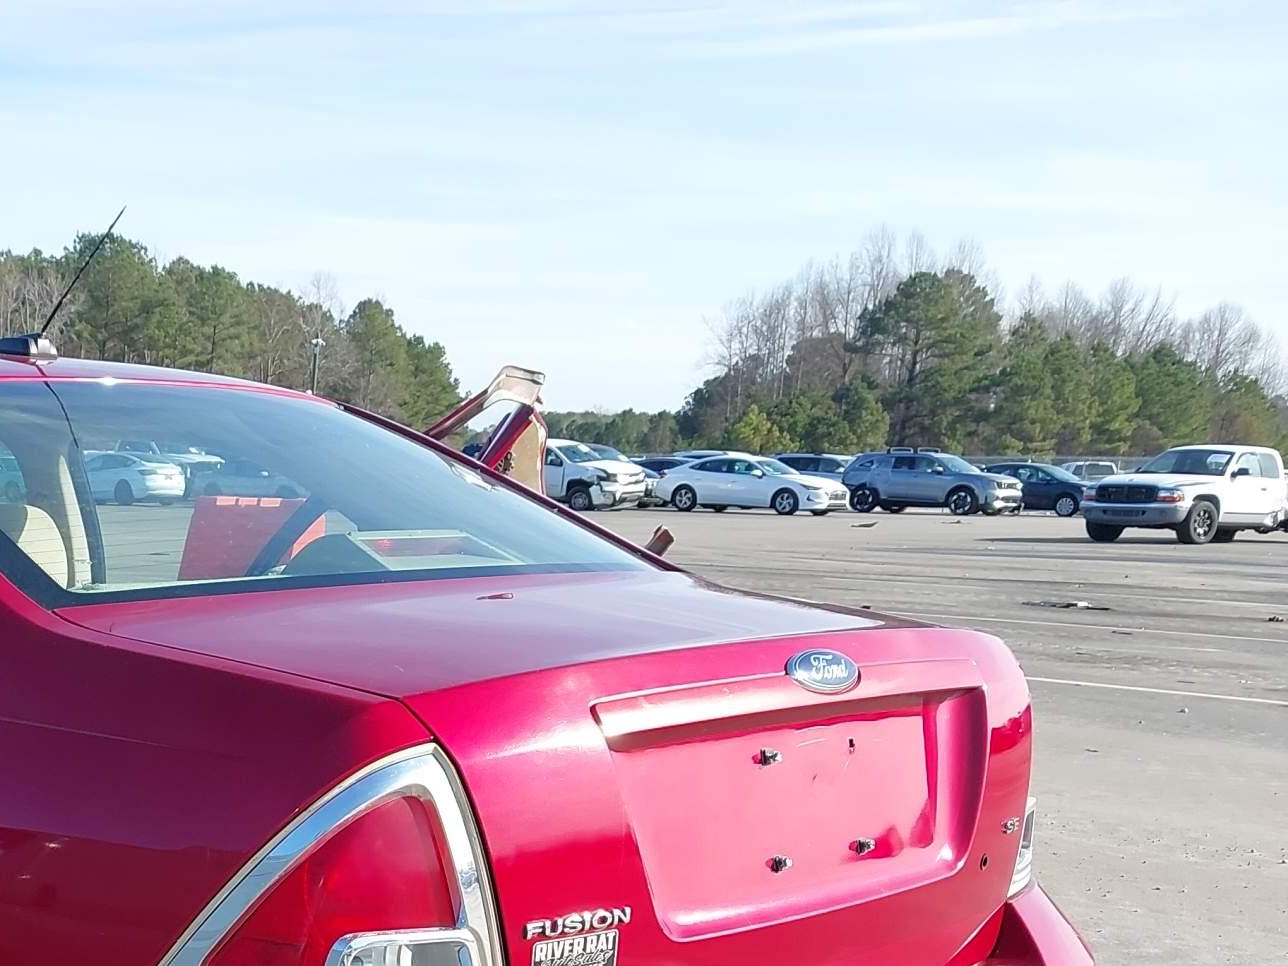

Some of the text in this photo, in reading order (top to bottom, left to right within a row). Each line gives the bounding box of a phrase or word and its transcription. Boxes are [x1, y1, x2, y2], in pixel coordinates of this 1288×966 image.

[523, 906, 632, 940] FUSION
[535, 932, 616, 961] RIVER RAT
